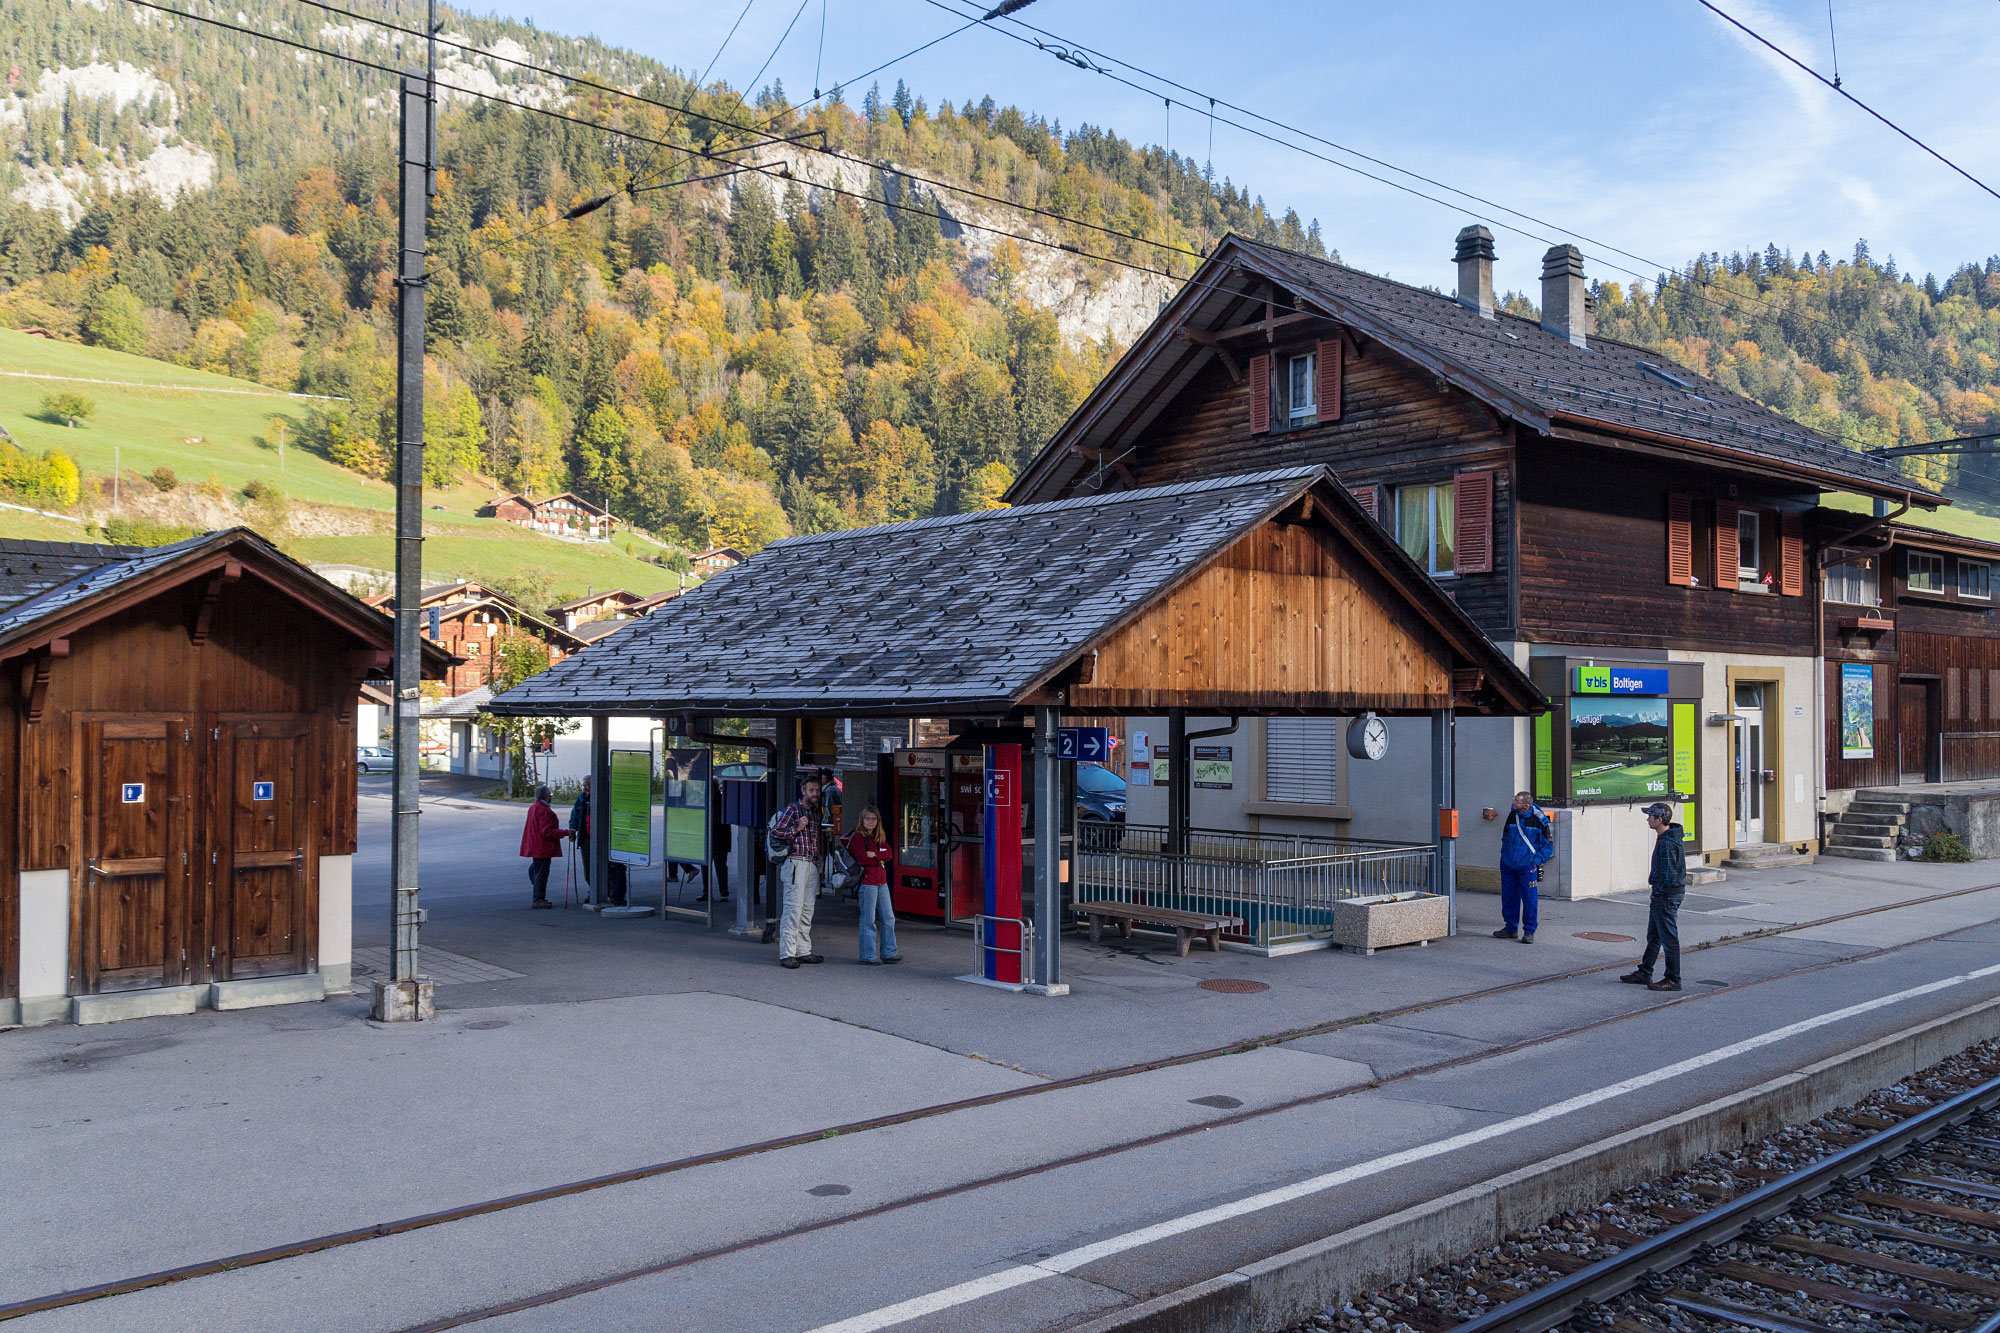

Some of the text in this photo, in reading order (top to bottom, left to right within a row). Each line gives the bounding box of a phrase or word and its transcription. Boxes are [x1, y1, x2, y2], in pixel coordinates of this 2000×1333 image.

[1594, 676, 1642, 691] bls Boltigen
[408, 690, 415, 698] 18
[1575, 715, 1602, 725] Ausflüge!
[1063, 737, 1073, 755] 2
[1653, 780, 1664, 790] bls
[1576, 787, 1602, 795] www.bls.ch
